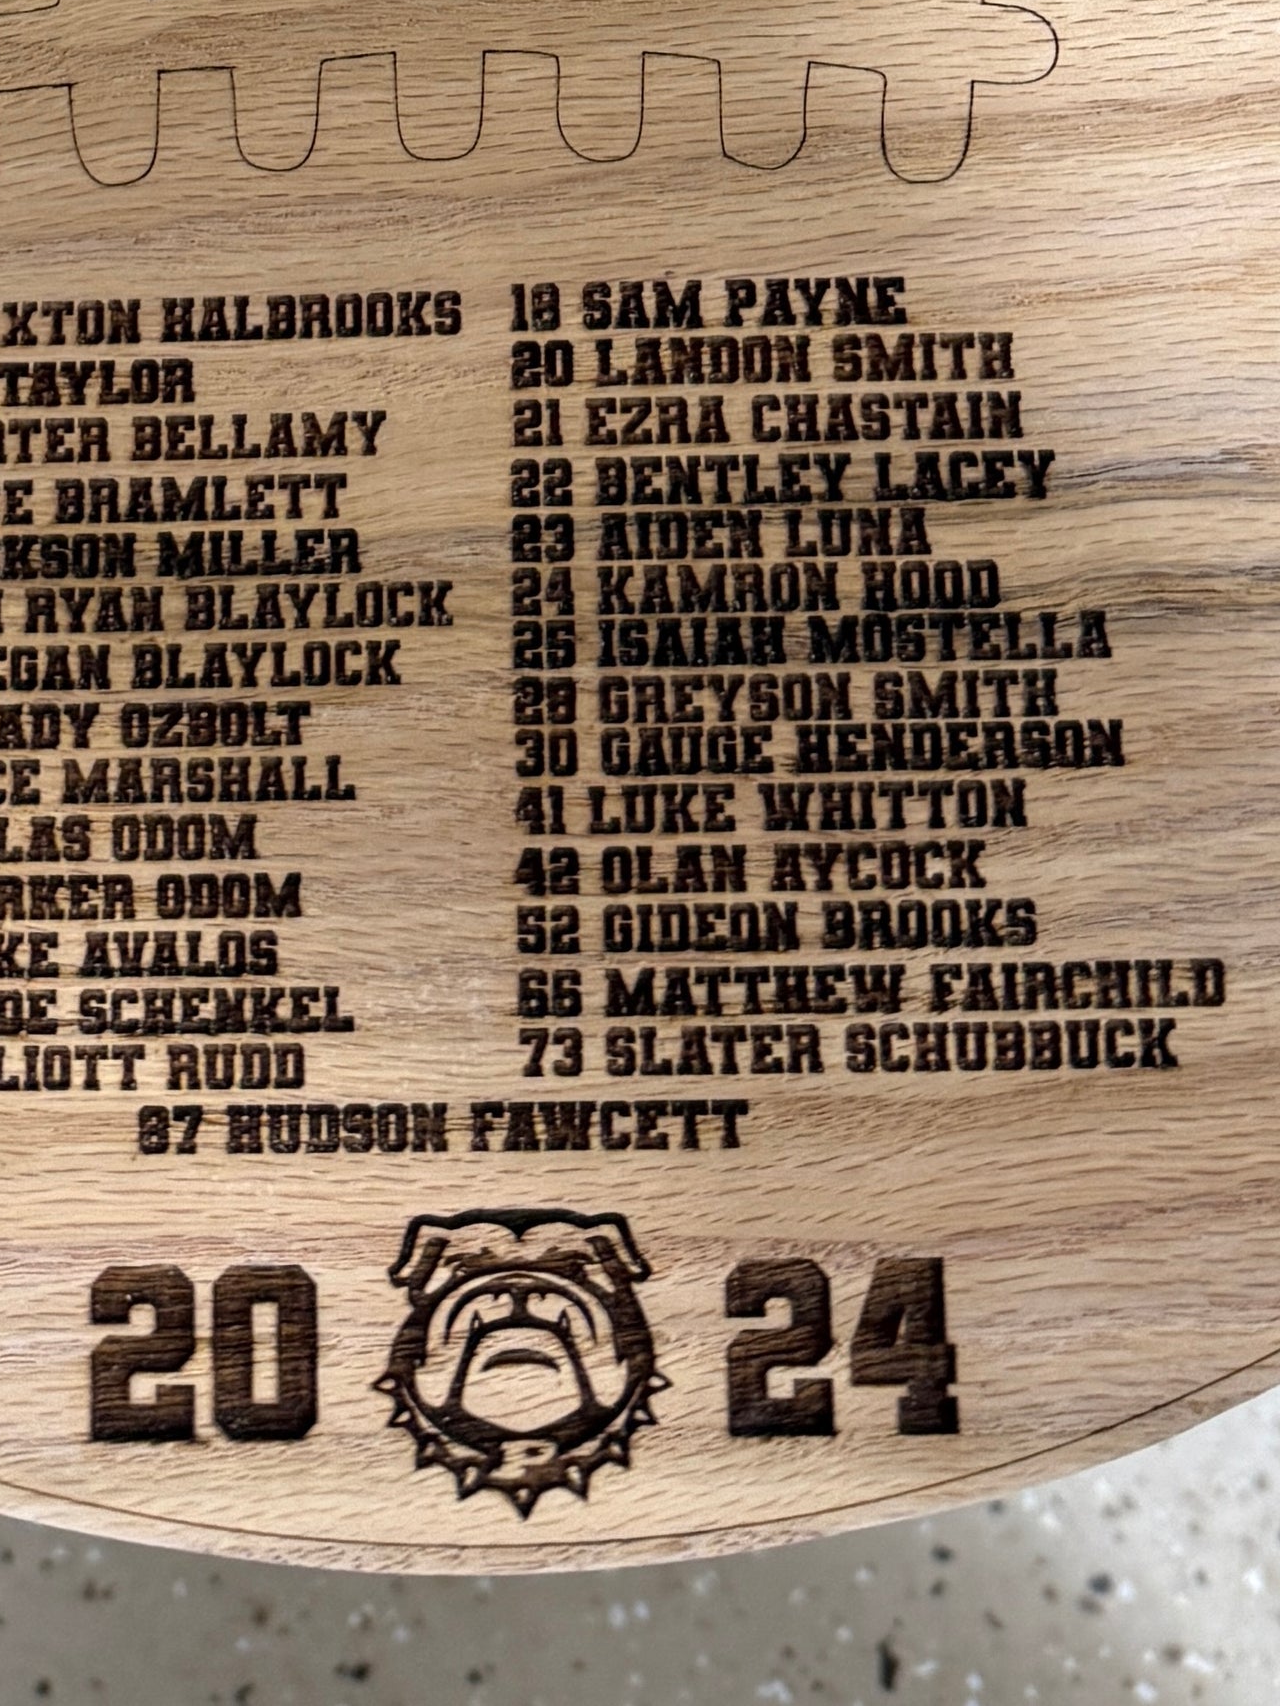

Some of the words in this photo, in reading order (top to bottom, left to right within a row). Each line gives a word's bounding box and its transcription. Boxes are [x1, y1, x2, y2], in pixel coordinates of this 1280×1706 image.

[161, 293, 462, 343] HALBROOKS
[132, 412, 386, 461] BELLAMY
[56, 474, 347, 523] BRAMLETT
[158, 529, 360, 578] MILLER
[25, 584, 164, 633] RYAN
[186, 581, 453, 629] BLAYLOCK
[133, 641, 401, 689] BLAYLOCK
[121, 701, 311, 747] OZBOLT
[63, 755, 356, 803] MARSHALL
[112, 815, 256, 860] ODOM
[155, 874, 301, 919] ODOM
[81, 930, 278, 977] AVALOS
[78, 987, 354, 1034] SCHENKEL
[167, 1044, 305, 1090] RUDD
[138, 1108, 199, 1154] 87
[226, 1106, 446, 1153] HUDSON
[471, 1101, 749, 1151] FAWCETT
[89, 1264, 319, 1442] 20
[723, 1257, 959, 1436] 24
